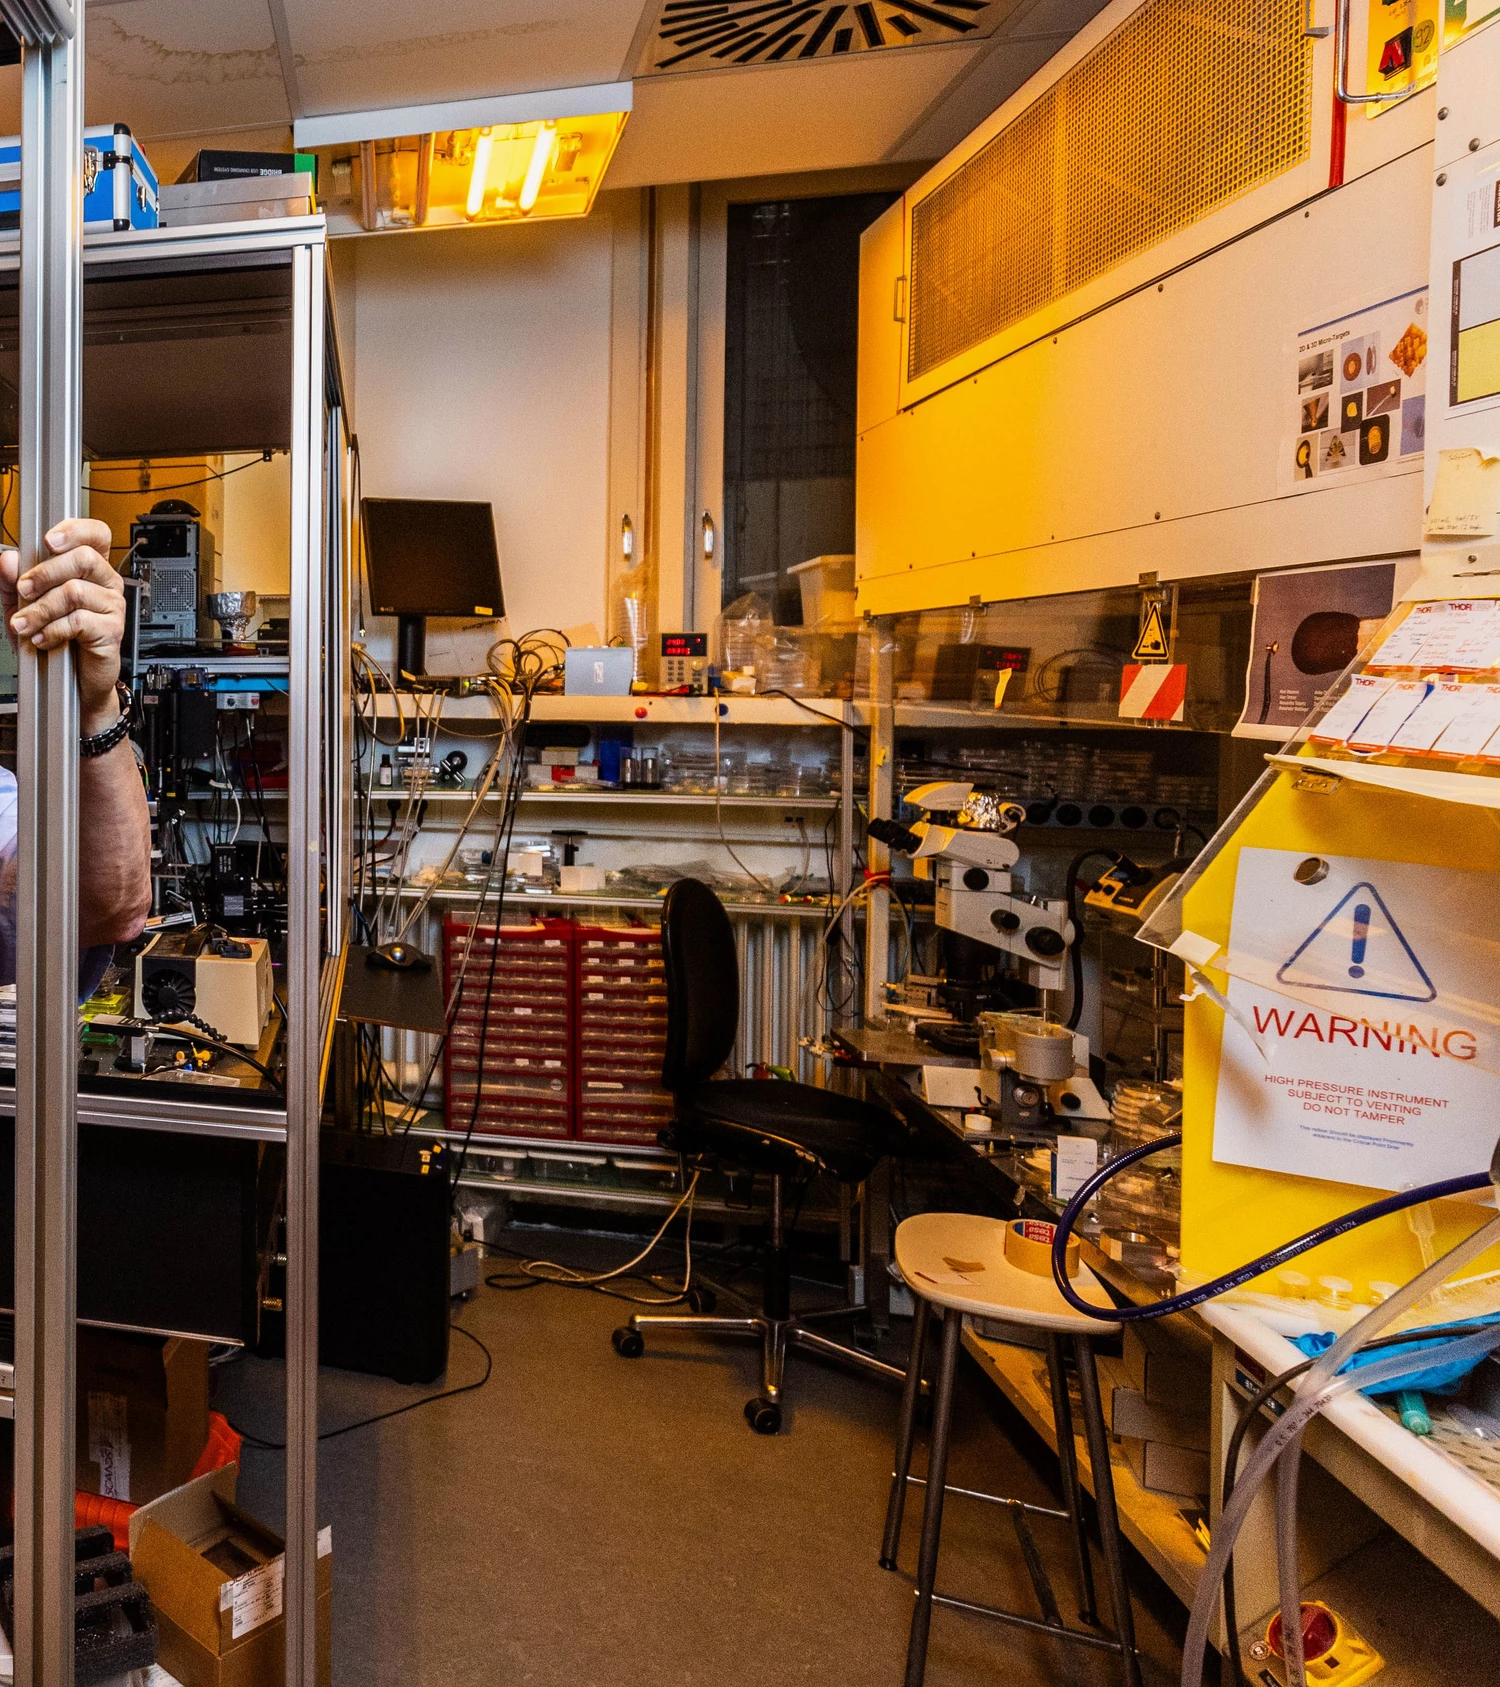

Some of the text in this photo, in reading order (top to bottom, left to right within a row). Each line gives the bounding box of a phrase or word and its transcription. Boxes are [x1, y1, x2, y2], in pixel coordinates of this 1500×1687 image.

[260, 168, 282, 176] BRIDGE
[1318, 330, 1350, 346] Micro-Targets
[1253, 1005, 1477, 1060] WARNING
[1264, 1074, 1450, 1109] HIGH PRESSURE INSTRUMENT
[1287, 1088, 1422, 1116] SUBJECT TO VENTING
[1303, 1102, 1405, 1125] DO NOT TAMPER
[1029, 1226, 1051, 1236] tesa
[1029, 1233, 1051, 1243] tesa
